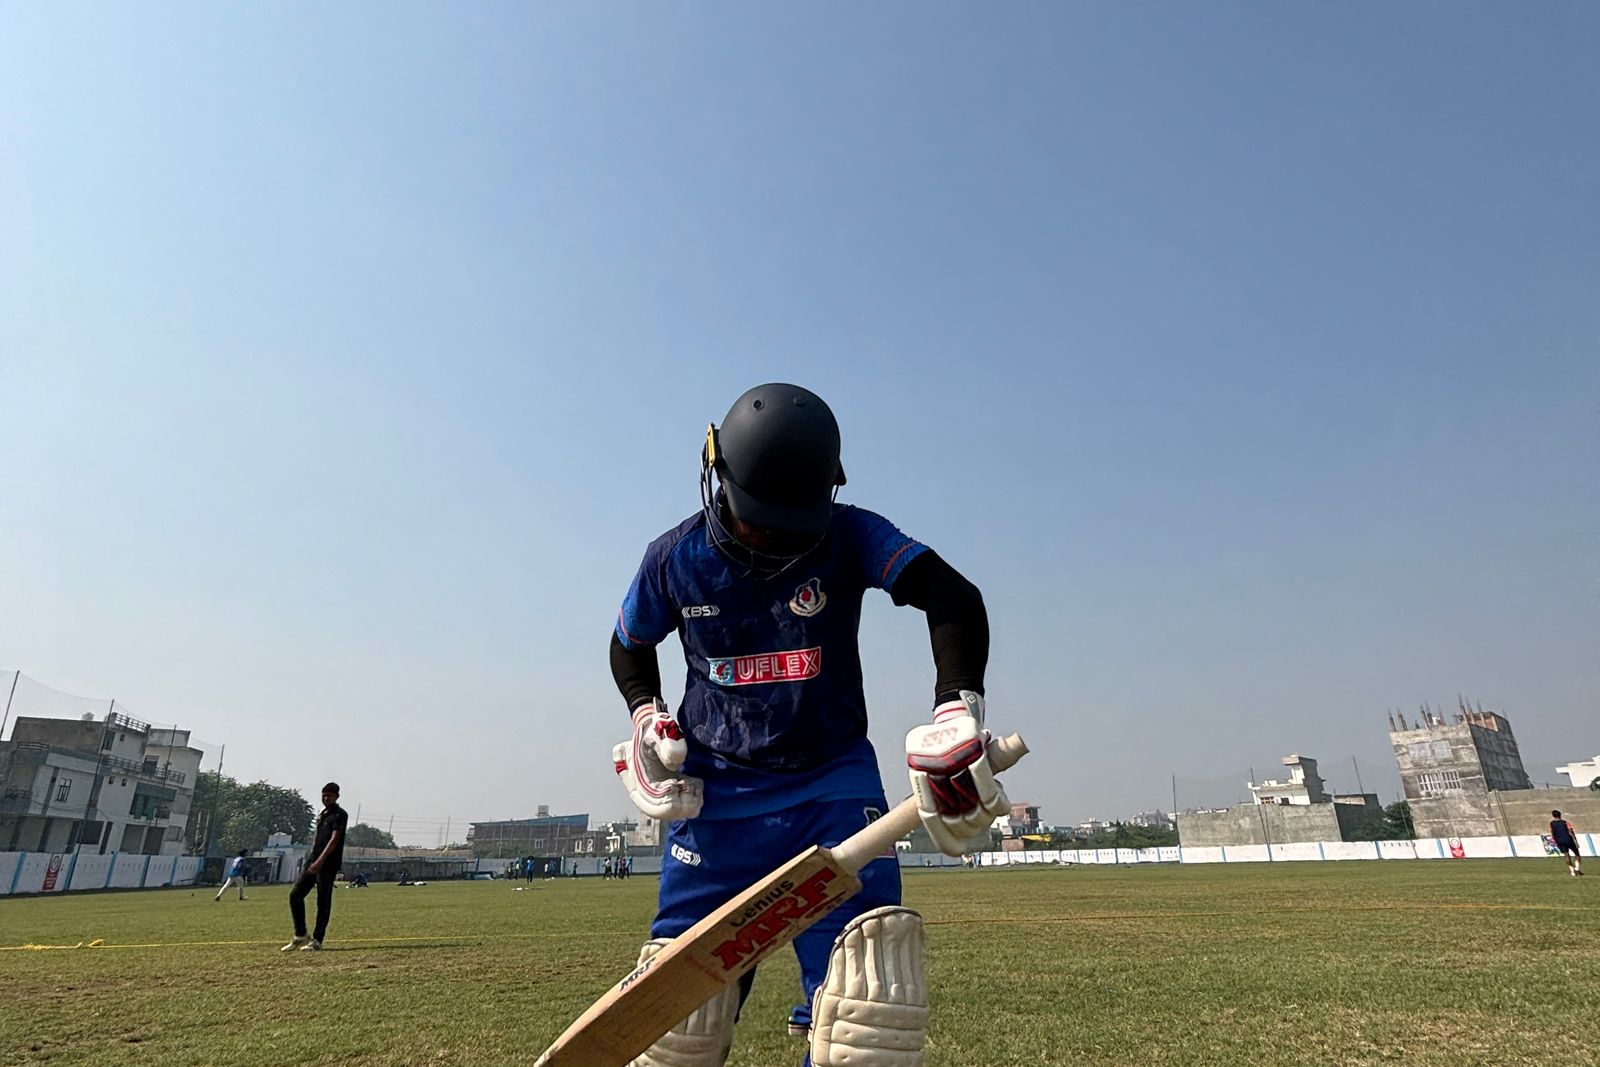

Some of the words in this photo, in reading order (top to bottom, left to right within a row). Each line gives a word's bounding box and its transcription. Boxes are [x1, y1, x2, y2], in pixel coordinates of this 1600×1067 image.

[737, 651, 817, 680] UFLEX
[711, 867, 837, 971] MRF
[619, 957, 657, 992] MRF
